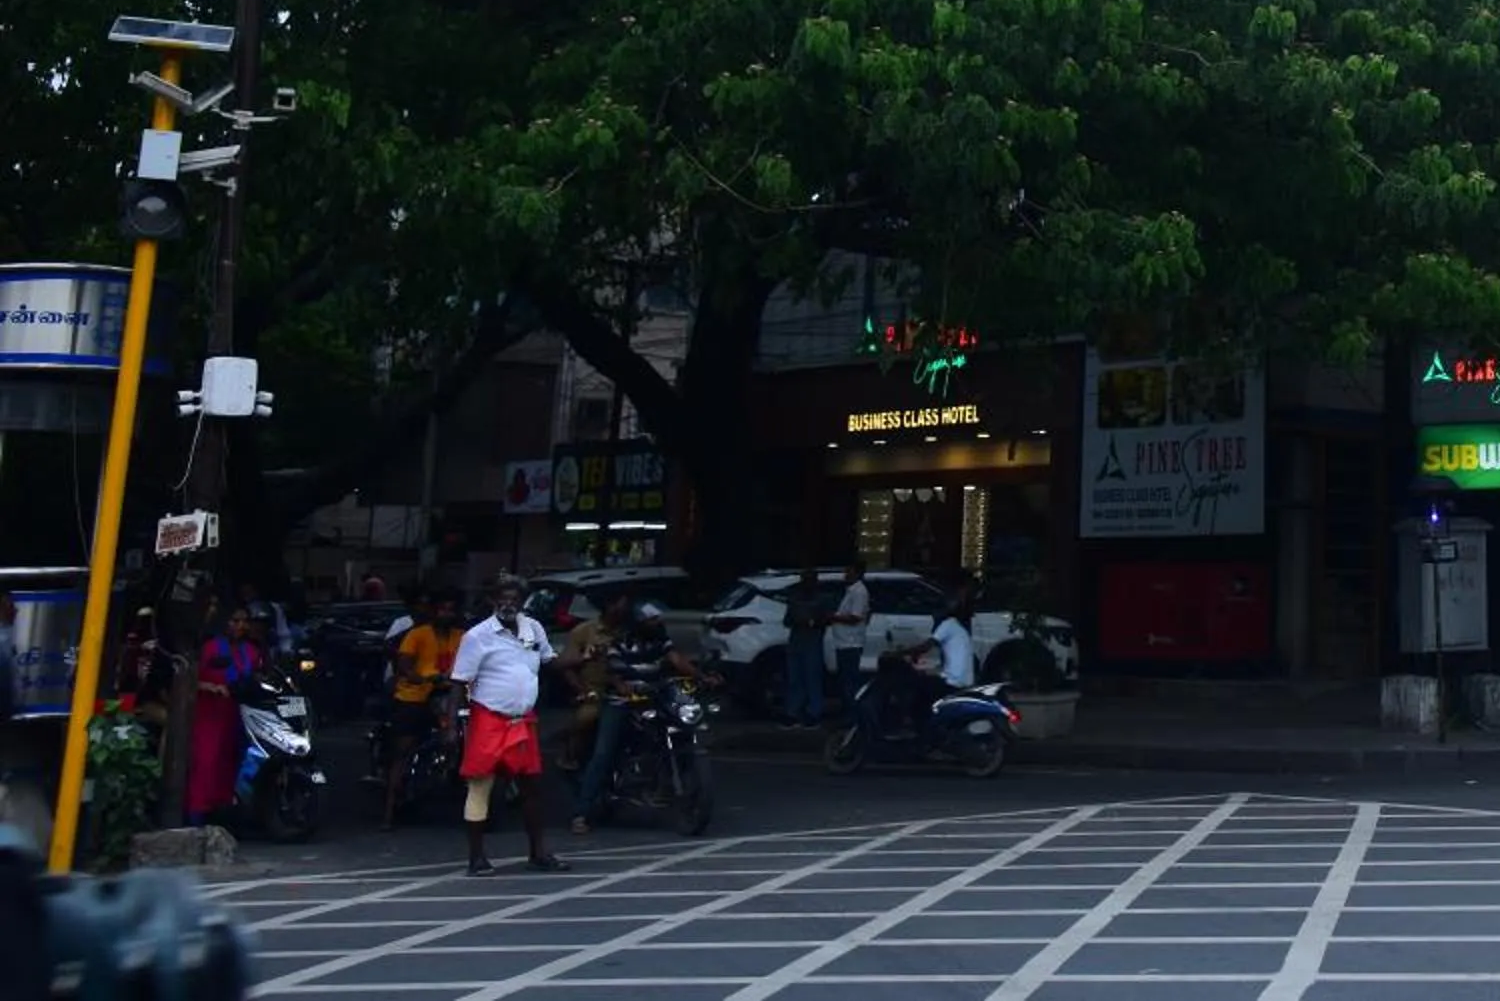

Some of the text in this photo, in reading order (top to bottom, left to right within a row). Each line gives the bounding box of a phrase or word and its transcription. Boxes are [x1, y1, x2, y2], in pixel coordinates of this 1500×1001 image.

[847, 404, 980, 432] BUSINESS CLASS HOTEL
[1135, 437, 1247, 475] PINE TREE
